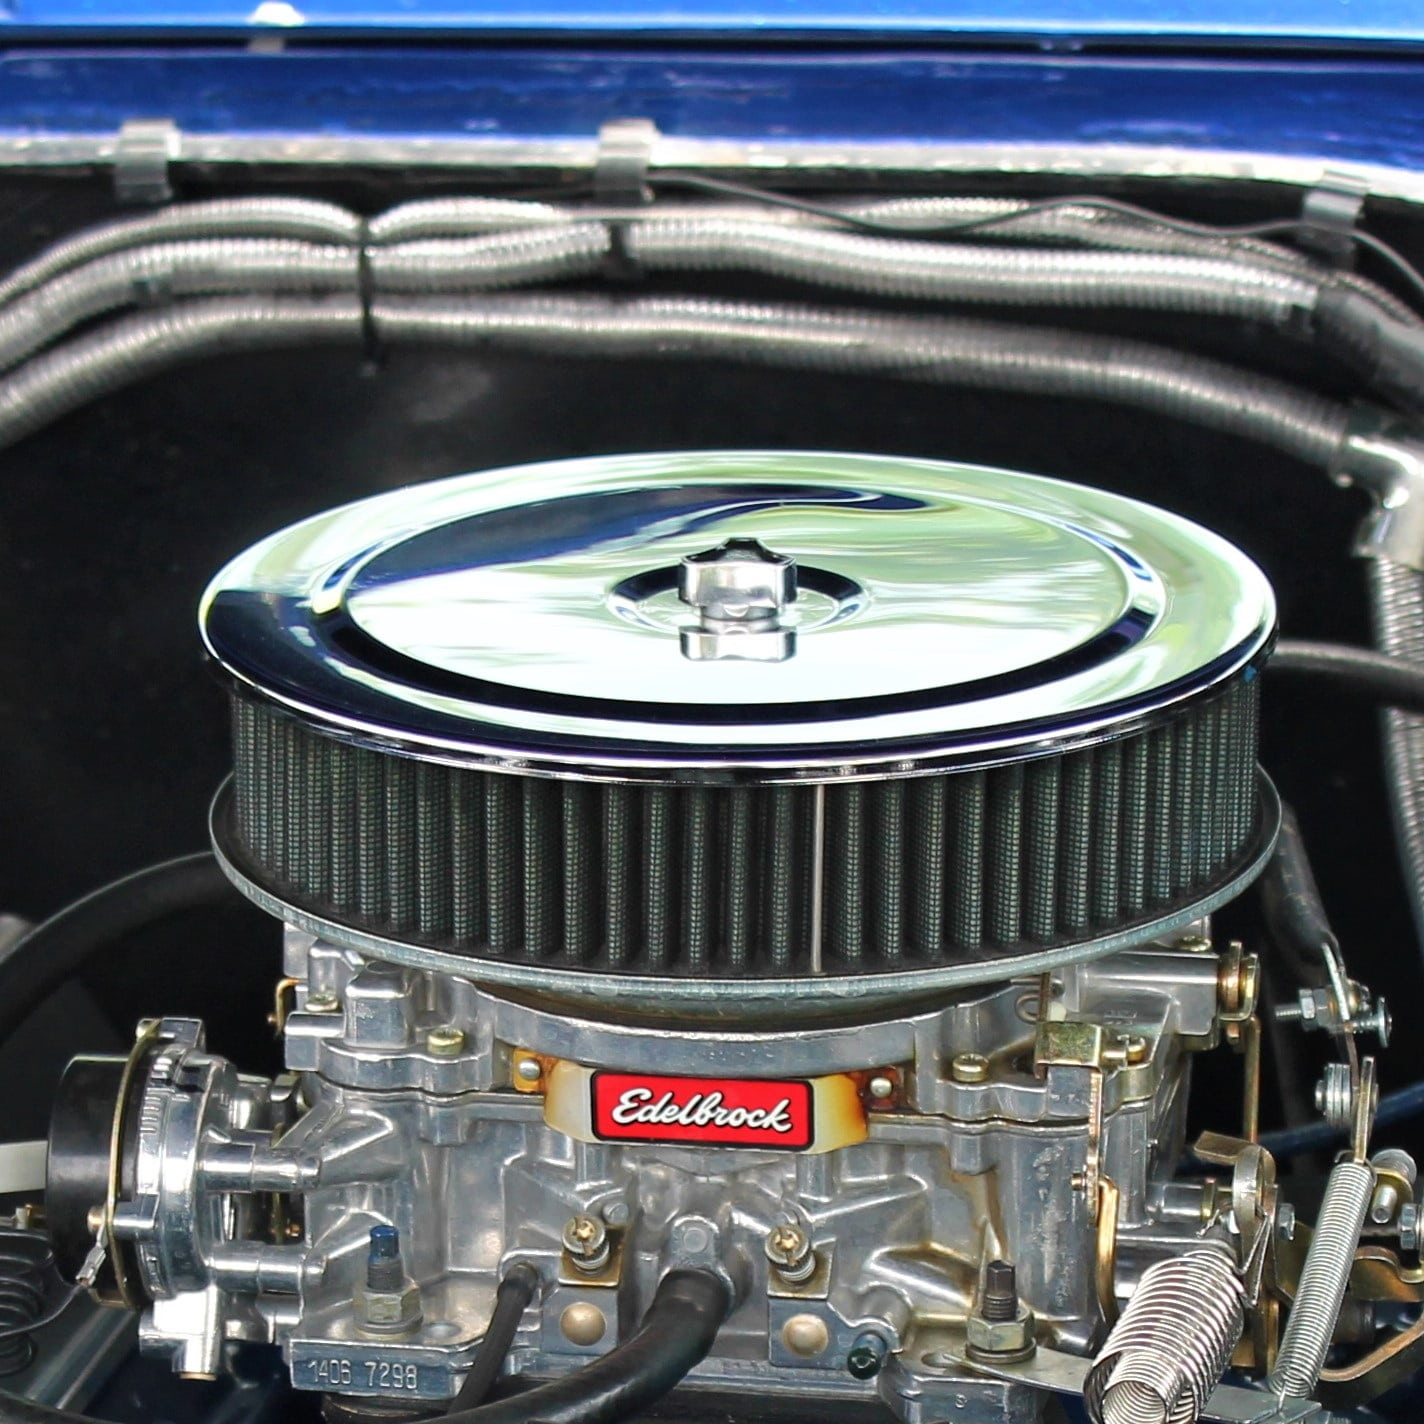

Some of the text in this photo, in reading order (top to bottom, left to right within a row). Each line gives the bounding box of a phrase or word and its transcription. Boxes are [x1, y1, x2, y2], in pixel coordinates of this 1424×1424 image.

[612, 1088, 792, 1132] Edelbrock
[307, 1359, 417, 1389] 1406 7298
